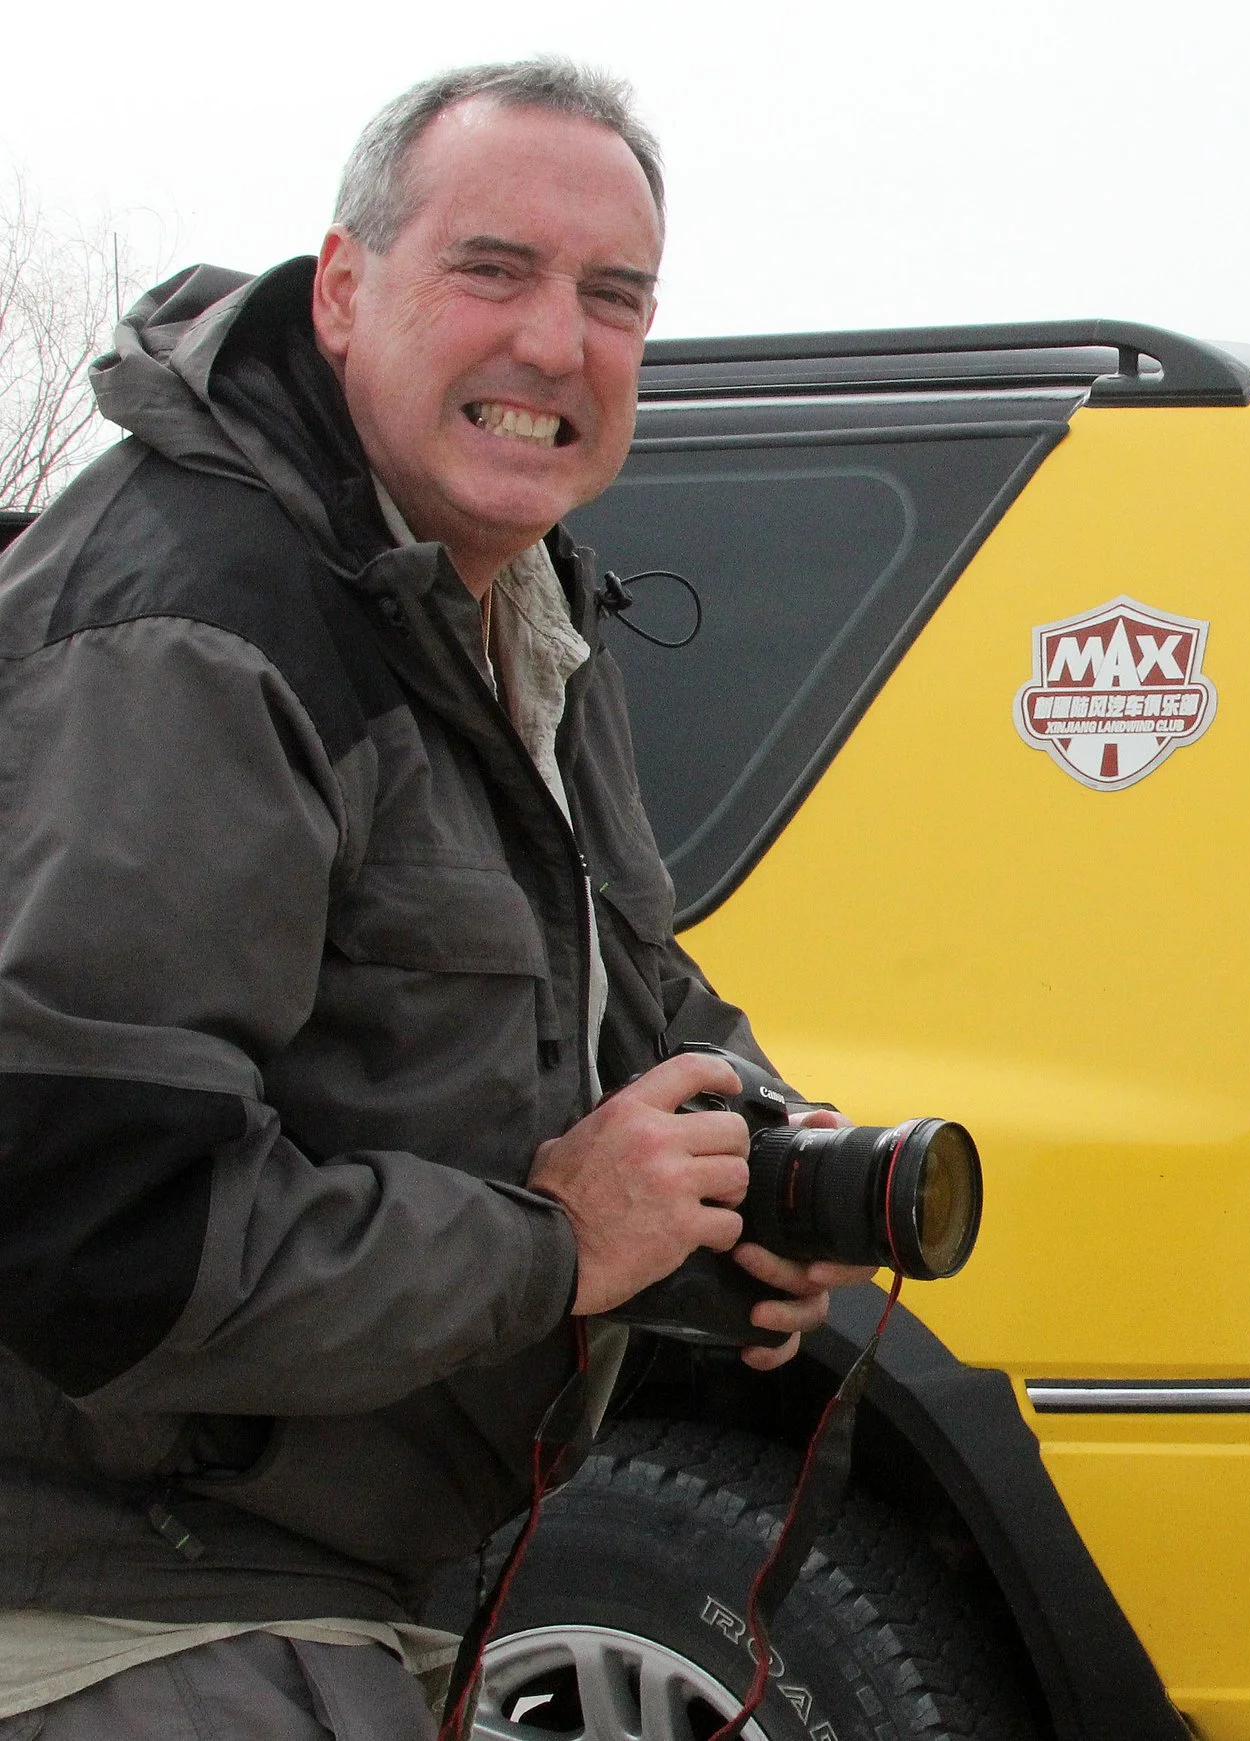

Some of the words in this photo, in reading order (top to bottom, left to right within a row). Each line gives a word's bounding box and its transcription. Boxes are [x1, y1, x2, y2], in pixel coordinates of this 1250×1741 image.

[1047, 617, 1185, 689] MAX
[1044, 721, 1097, 734] XINJIANG
[1098, 720, 1155, 733] LANDWIND
[1156, 719, 1185, 732] CLUB
